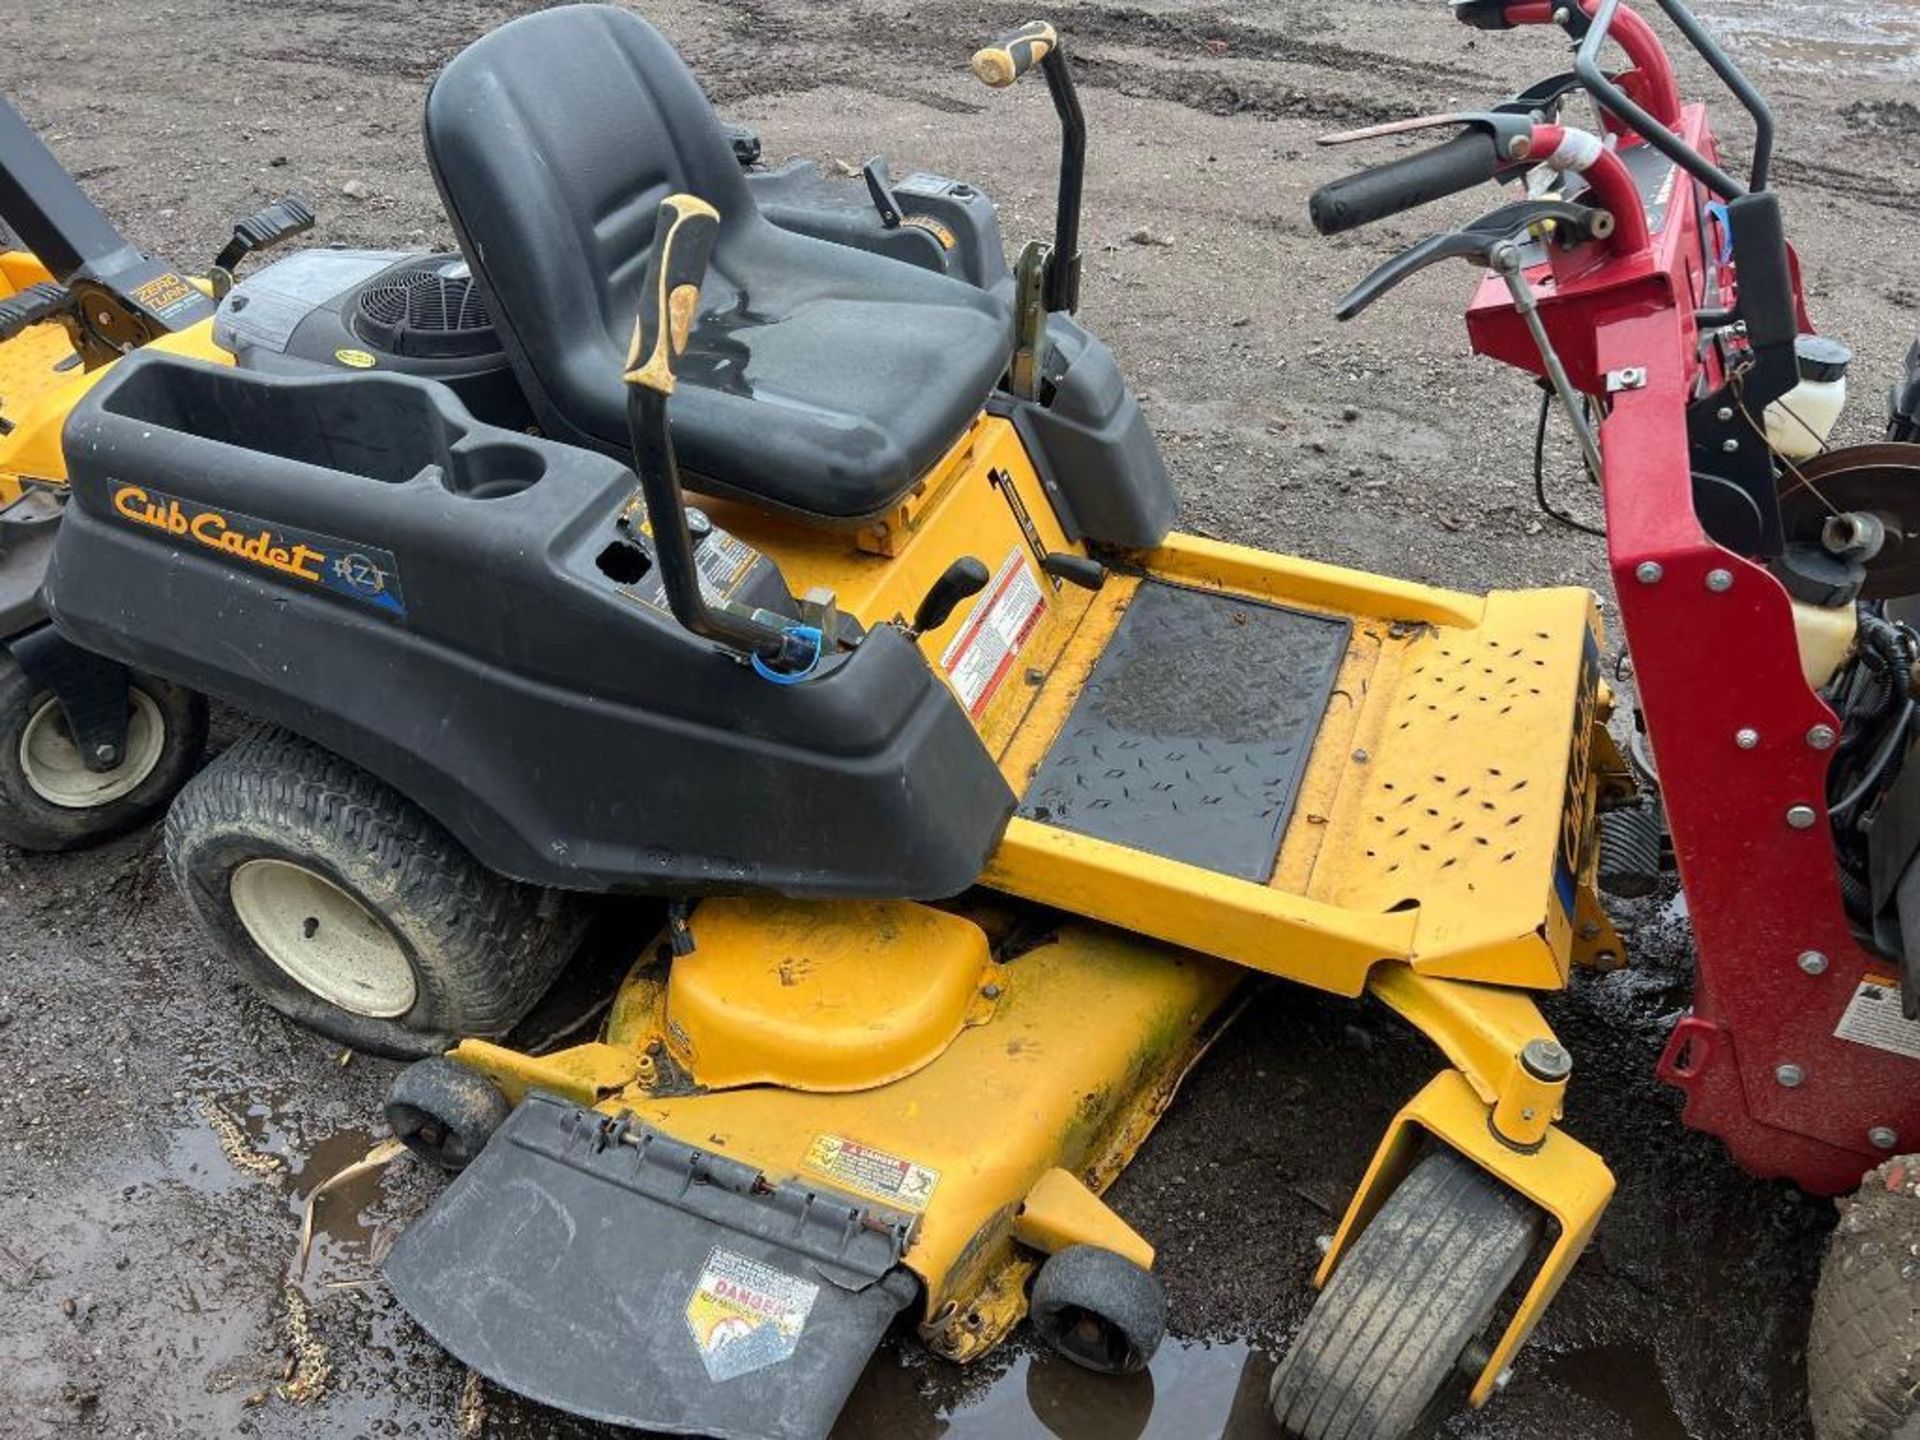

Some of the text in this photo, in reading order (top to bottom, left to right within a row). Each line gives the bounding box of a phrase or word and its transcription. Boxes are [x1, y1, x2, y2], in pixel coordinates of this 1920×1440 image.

[137, 272, 179, 301] ZERO
[147, 283, 190, 311] TURN
[114, 485, 327, 582] Cub Cadet
[332, 554, 390, 594] RZT
[859, 1148, 901, 1168] DANGER
[714, 1278, 786, 1319] DANGER
